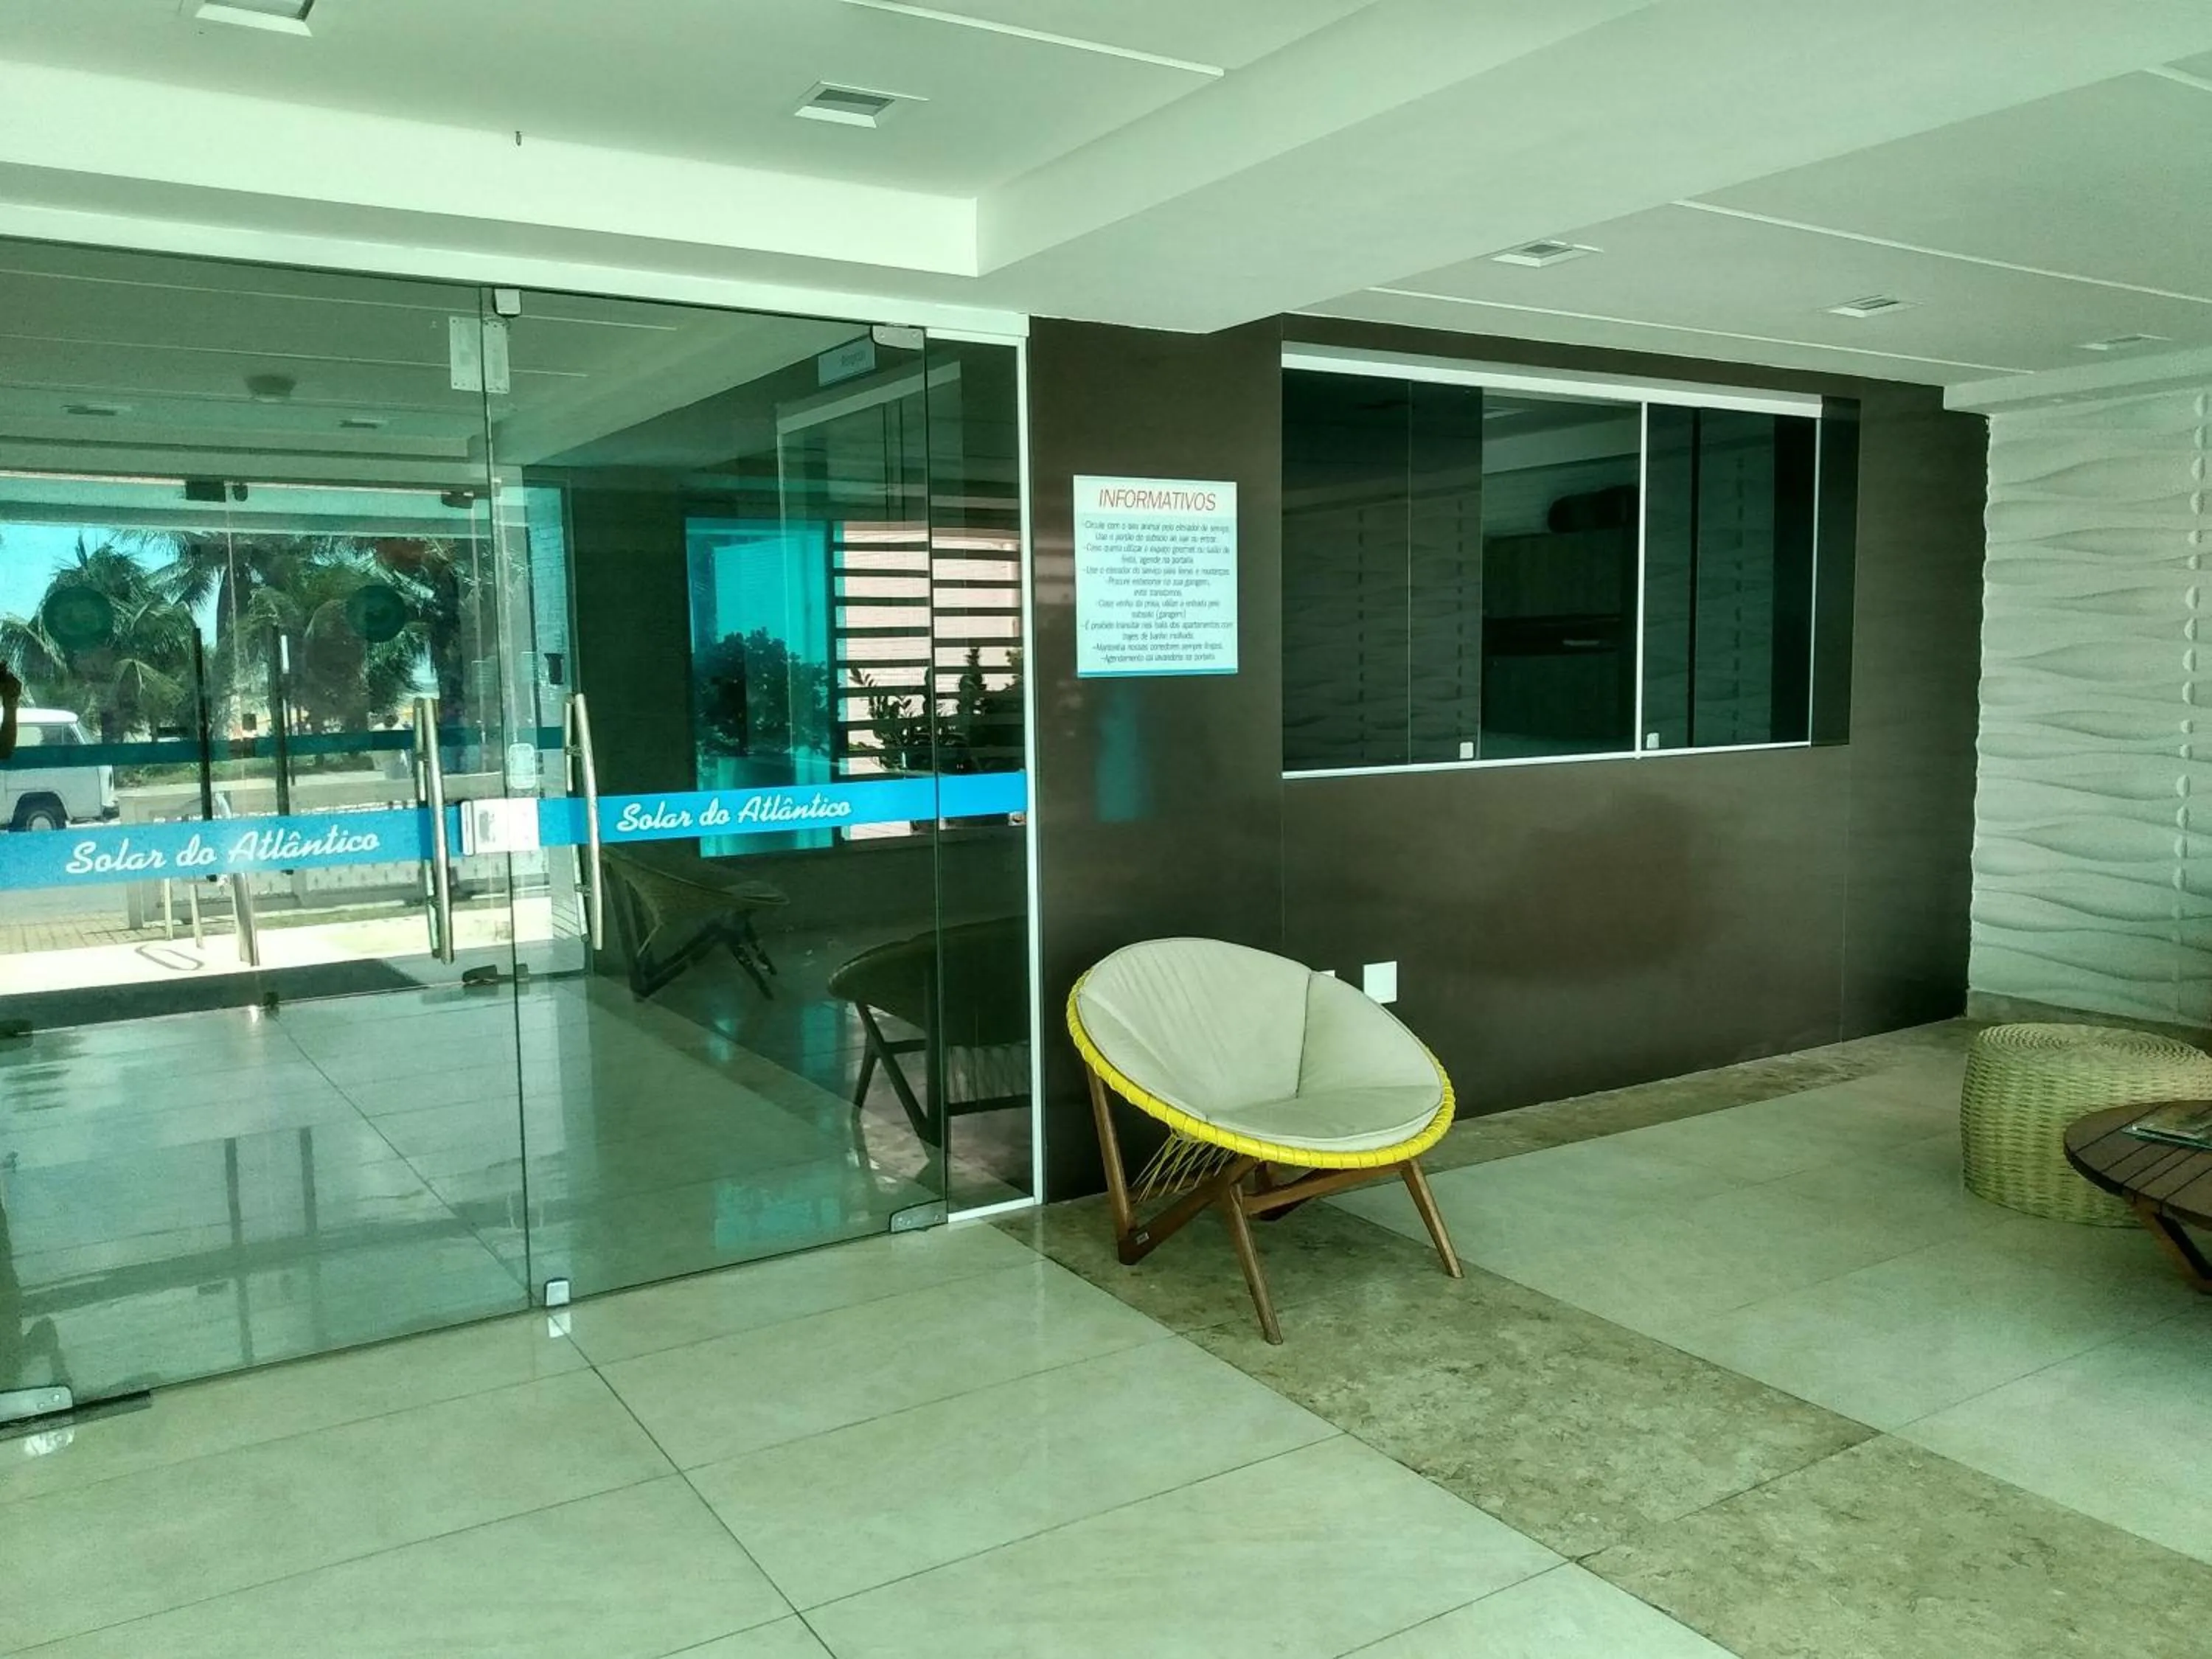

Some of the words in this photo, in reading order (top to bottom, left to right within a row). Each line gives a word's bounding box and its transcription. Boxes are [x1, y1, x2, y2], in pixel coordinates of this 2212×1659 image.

[1099, 488, 1217, 511] INFORMATIVOS
[616, 801, 693, 832] Solar
[699, 798, 730, 826] do
[738, 792, 851, 824] Atlântico
[66, 838, 167, 874] Solar
[176, 833, 218, 867] do
[228, 824, 380, 863] Atlântico
